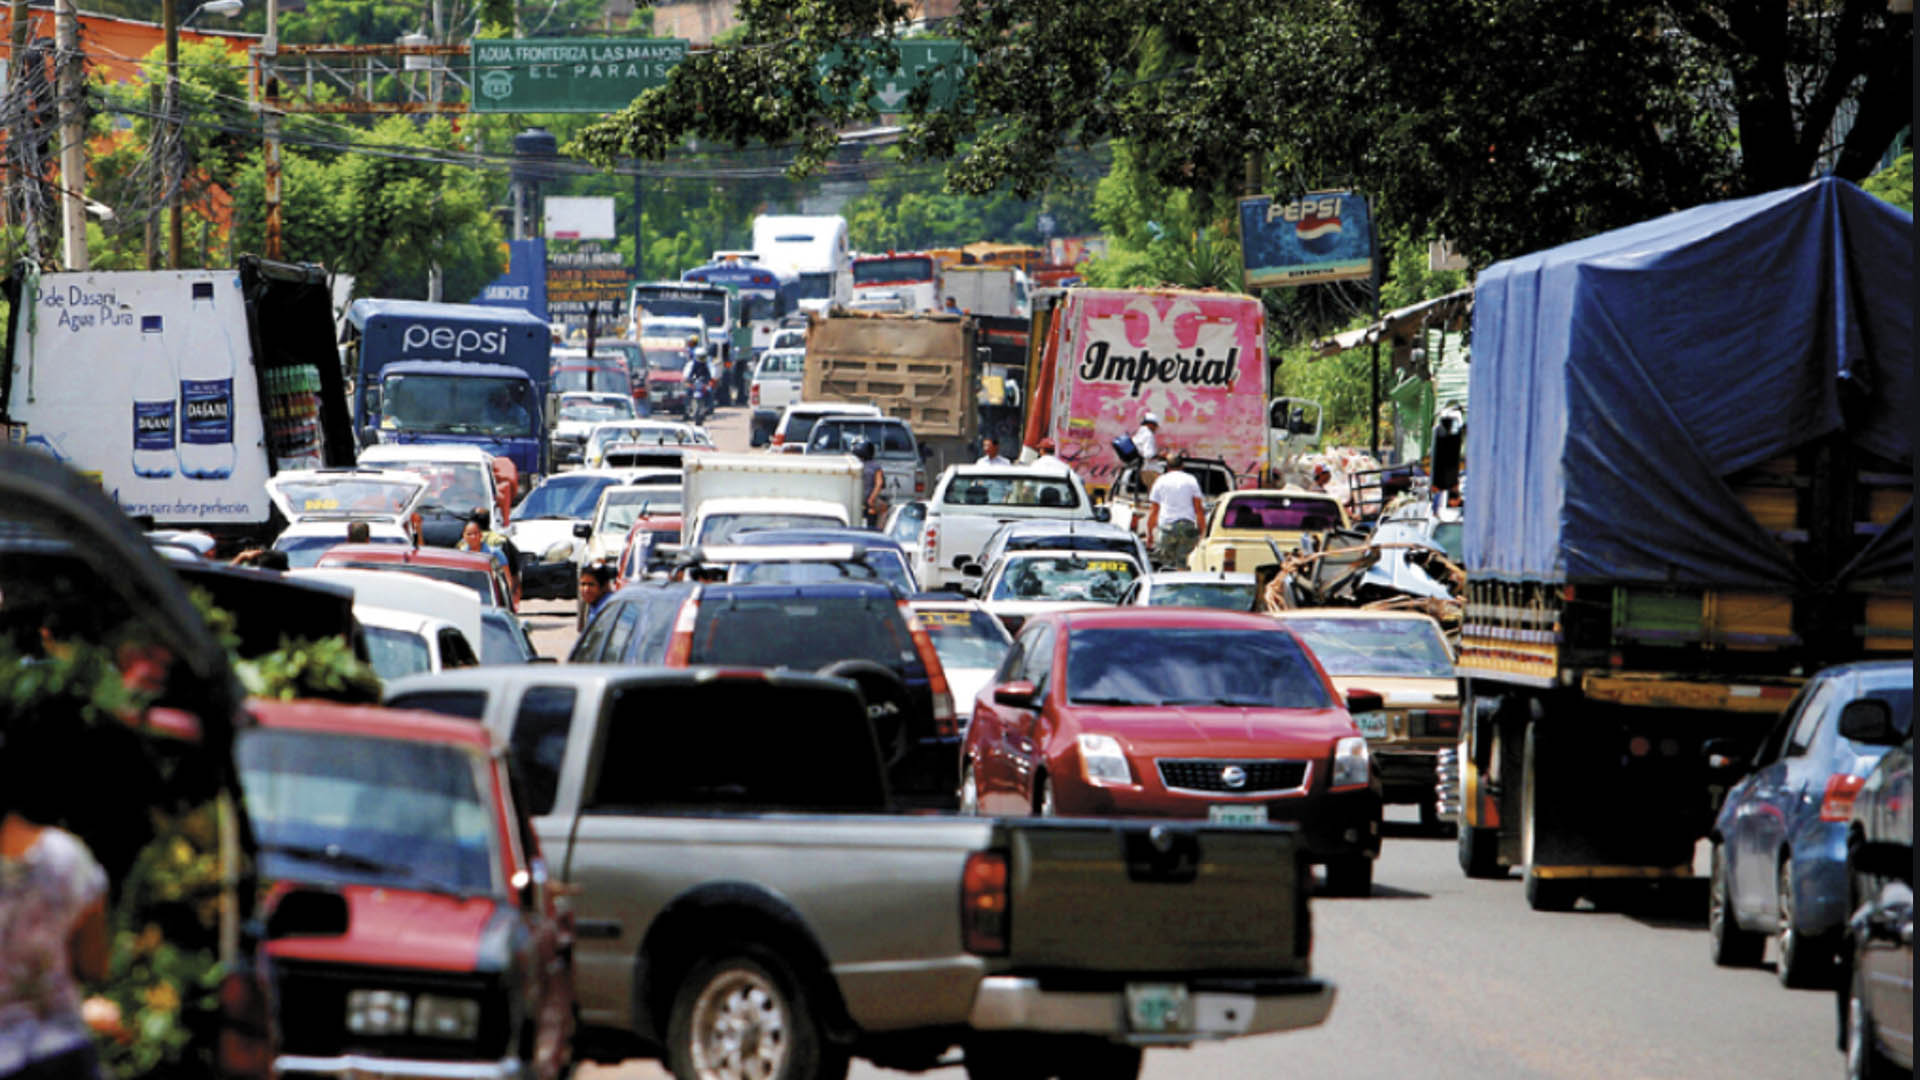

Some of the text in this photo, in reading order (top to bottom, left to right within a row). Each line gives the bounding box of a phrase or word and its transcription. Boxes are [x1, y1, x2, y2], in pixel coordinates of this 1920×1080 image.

[592, 46, 624, 62] LAS
[529, 64, 667, 79] EL PARAIS
[1266, 197, 1342, 224] PEPSI
[45, 286, 65, 308] de
[58, 304, 134, 332] Agua Pura
[402, 323, 508, 358] pepsi
[1080, 340, 1239, 397] Imperial
